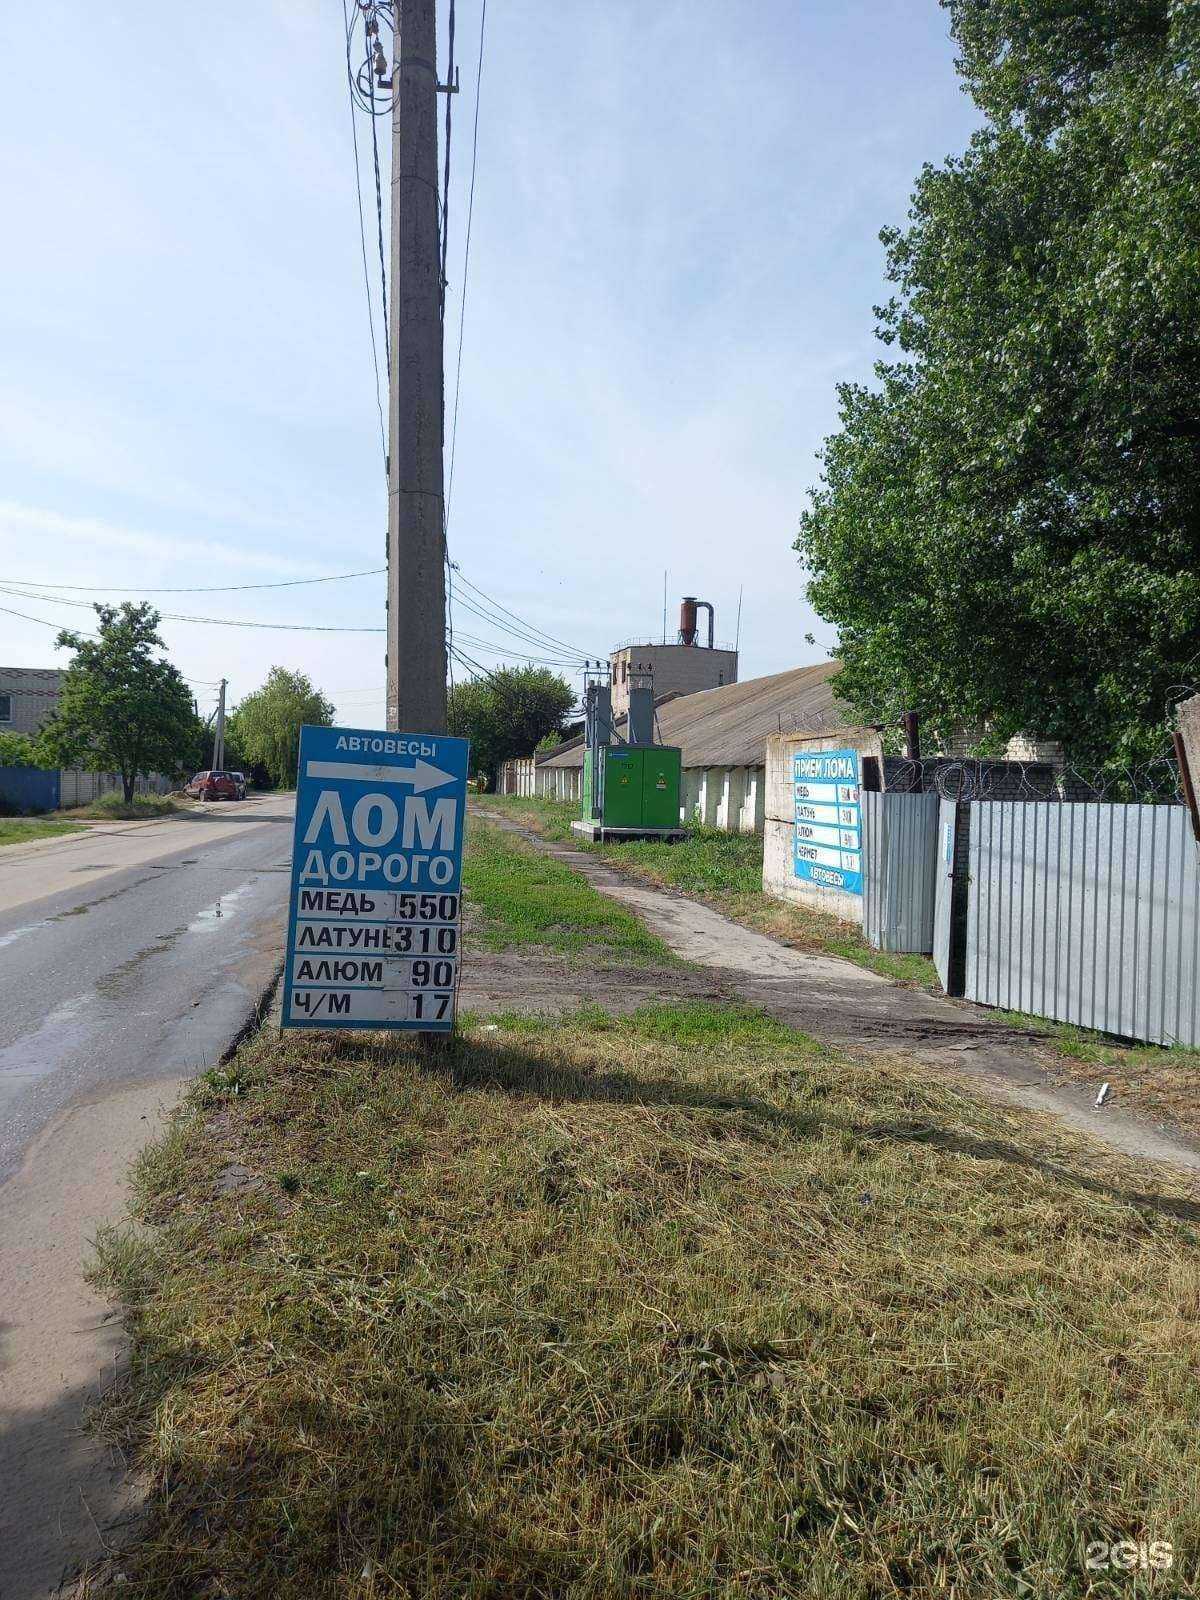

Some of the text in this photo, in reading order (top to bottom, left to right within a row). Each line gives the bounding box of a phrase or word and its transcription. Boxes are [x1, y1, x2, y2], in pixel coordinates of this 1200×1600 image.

[336, 735, 436, 757] АВТОВЕСЫ
[824, 757, 854, 780] ЛОМА
[303, 790, 457, 851] ЛОМ
[299, 849, 454, 886] ДОРОГО
[301, 890, 458, 921] МЕДЬ 550
[394, 926, 456, 954] 310
[296, 960, 453, 987] АЛЮМ 90
[295, 992, 450, 1019] Ч/М 17
